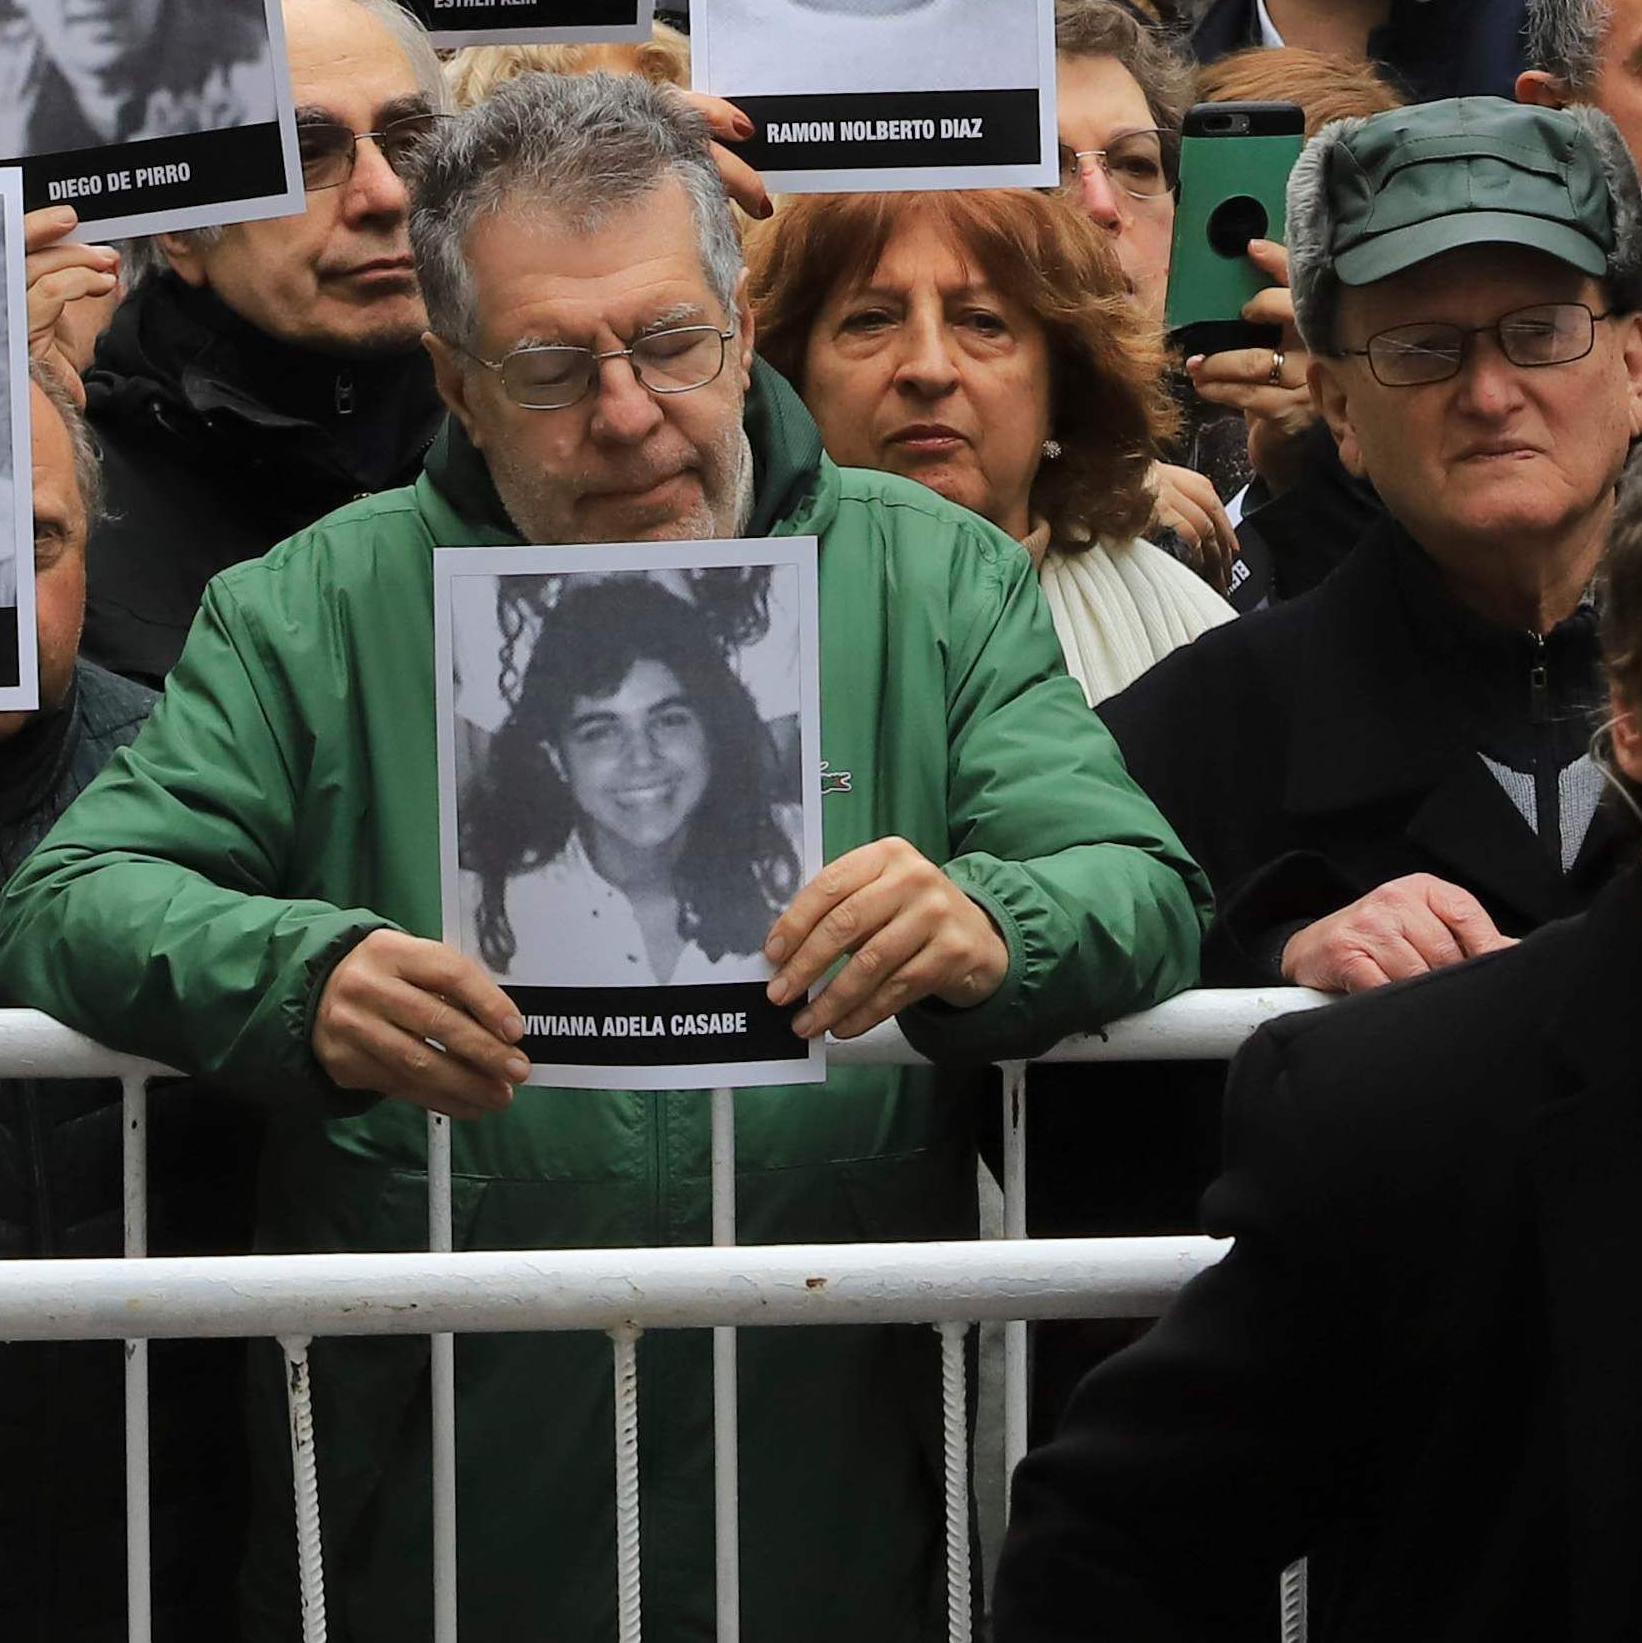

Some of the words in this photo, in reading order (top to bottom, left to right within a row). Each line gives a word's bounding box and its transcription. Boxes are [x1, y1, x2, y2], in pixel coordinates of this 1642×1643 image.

[766, 121, 835, 143] RAMON
[840, 119, 935, 142] NOLBERTO
[940, 117, 983, 139] DIAZ
[48, 175, 102, 201] DIEGO
[106, 170, 132, 192] DE
[135, 162, 191, 188] PIRRO
[522, 1011, 600, 1040] VIVIANA
[601, 1015, 666, 1037] ADELA
[670, 1012, 747, 1036] CASABE
